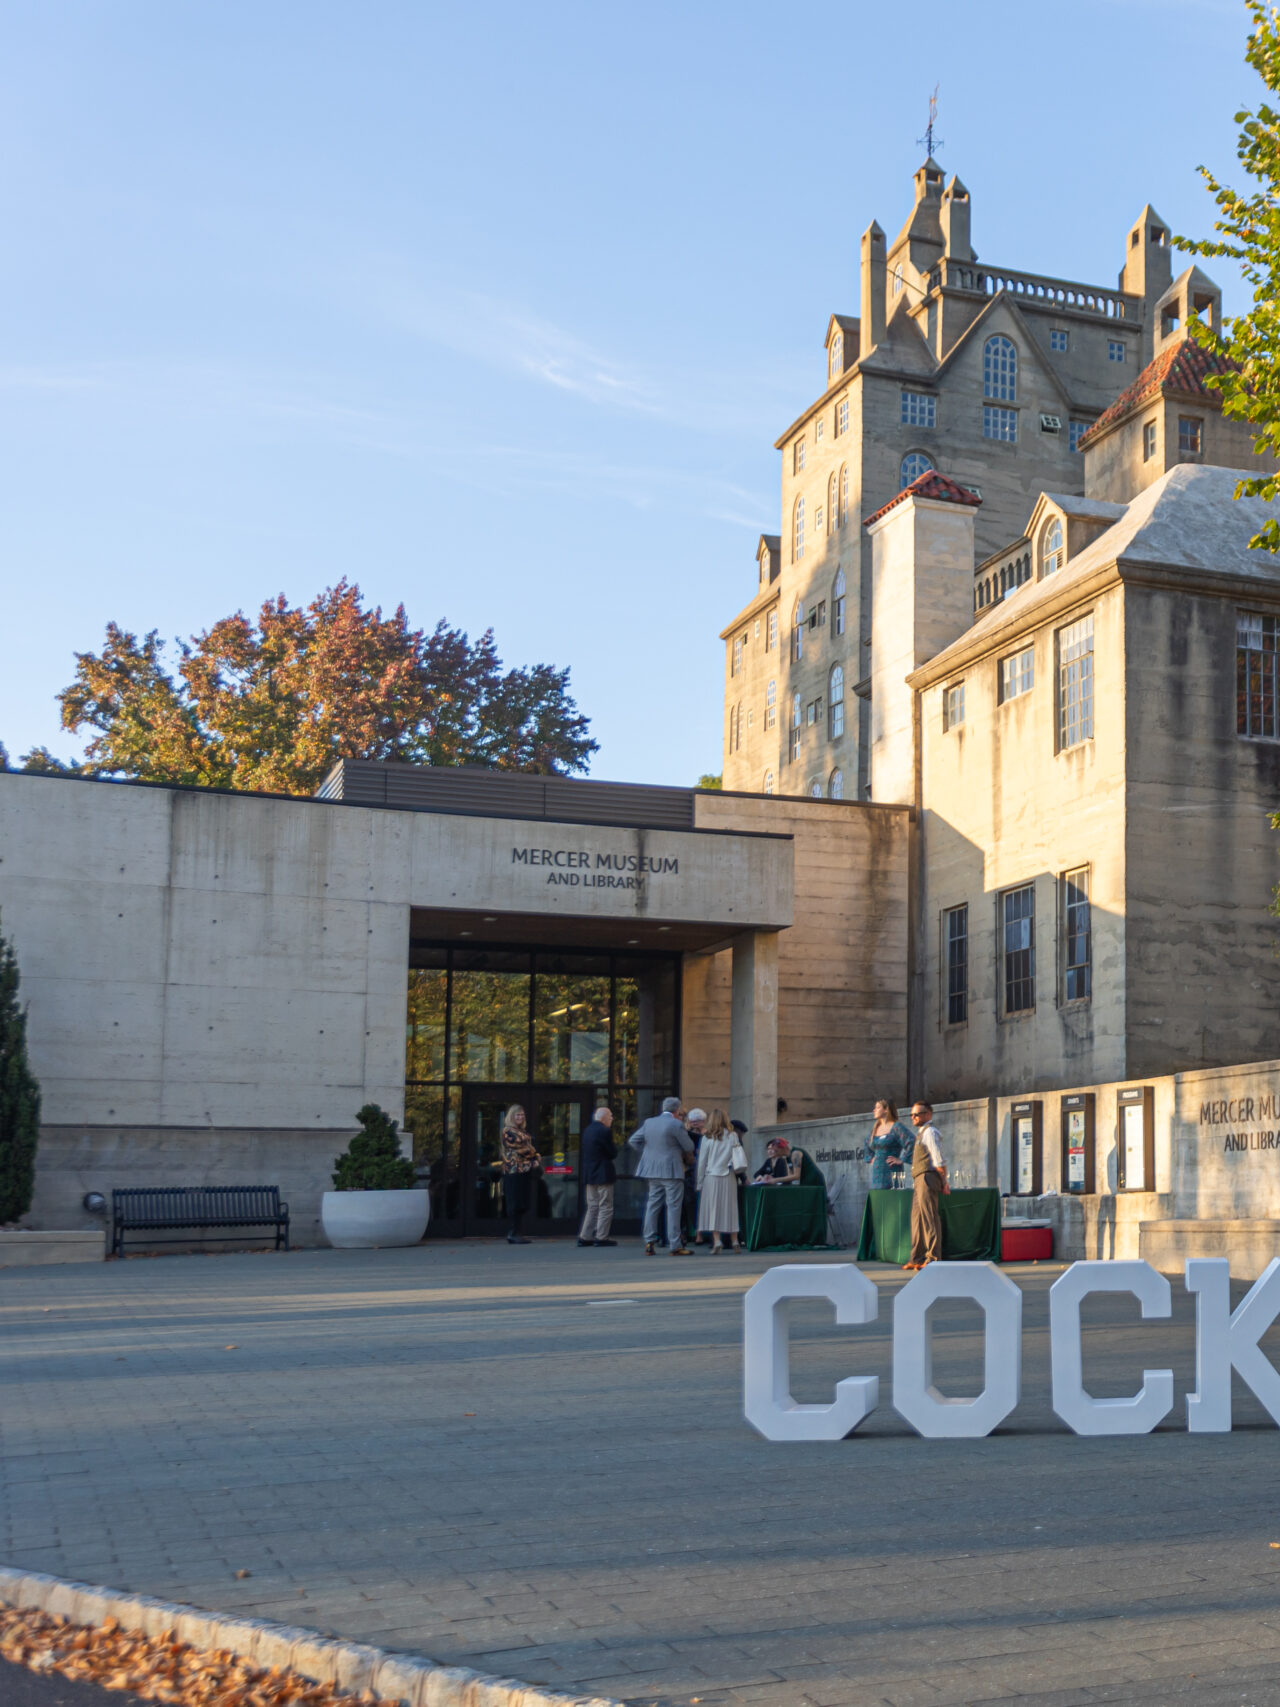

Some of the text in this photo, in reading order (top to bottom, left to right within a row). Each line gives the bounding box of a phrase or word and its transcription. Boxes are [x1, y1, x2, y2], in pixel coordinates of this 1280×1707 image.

[512, 848, 678, 874] MERCER MUSEUM
[547, 872, 645, 889] AND LIBRARY
[1200, 1097, 1254, 1125] MERCER
[1224, 1133, 1248, 1152] AND
